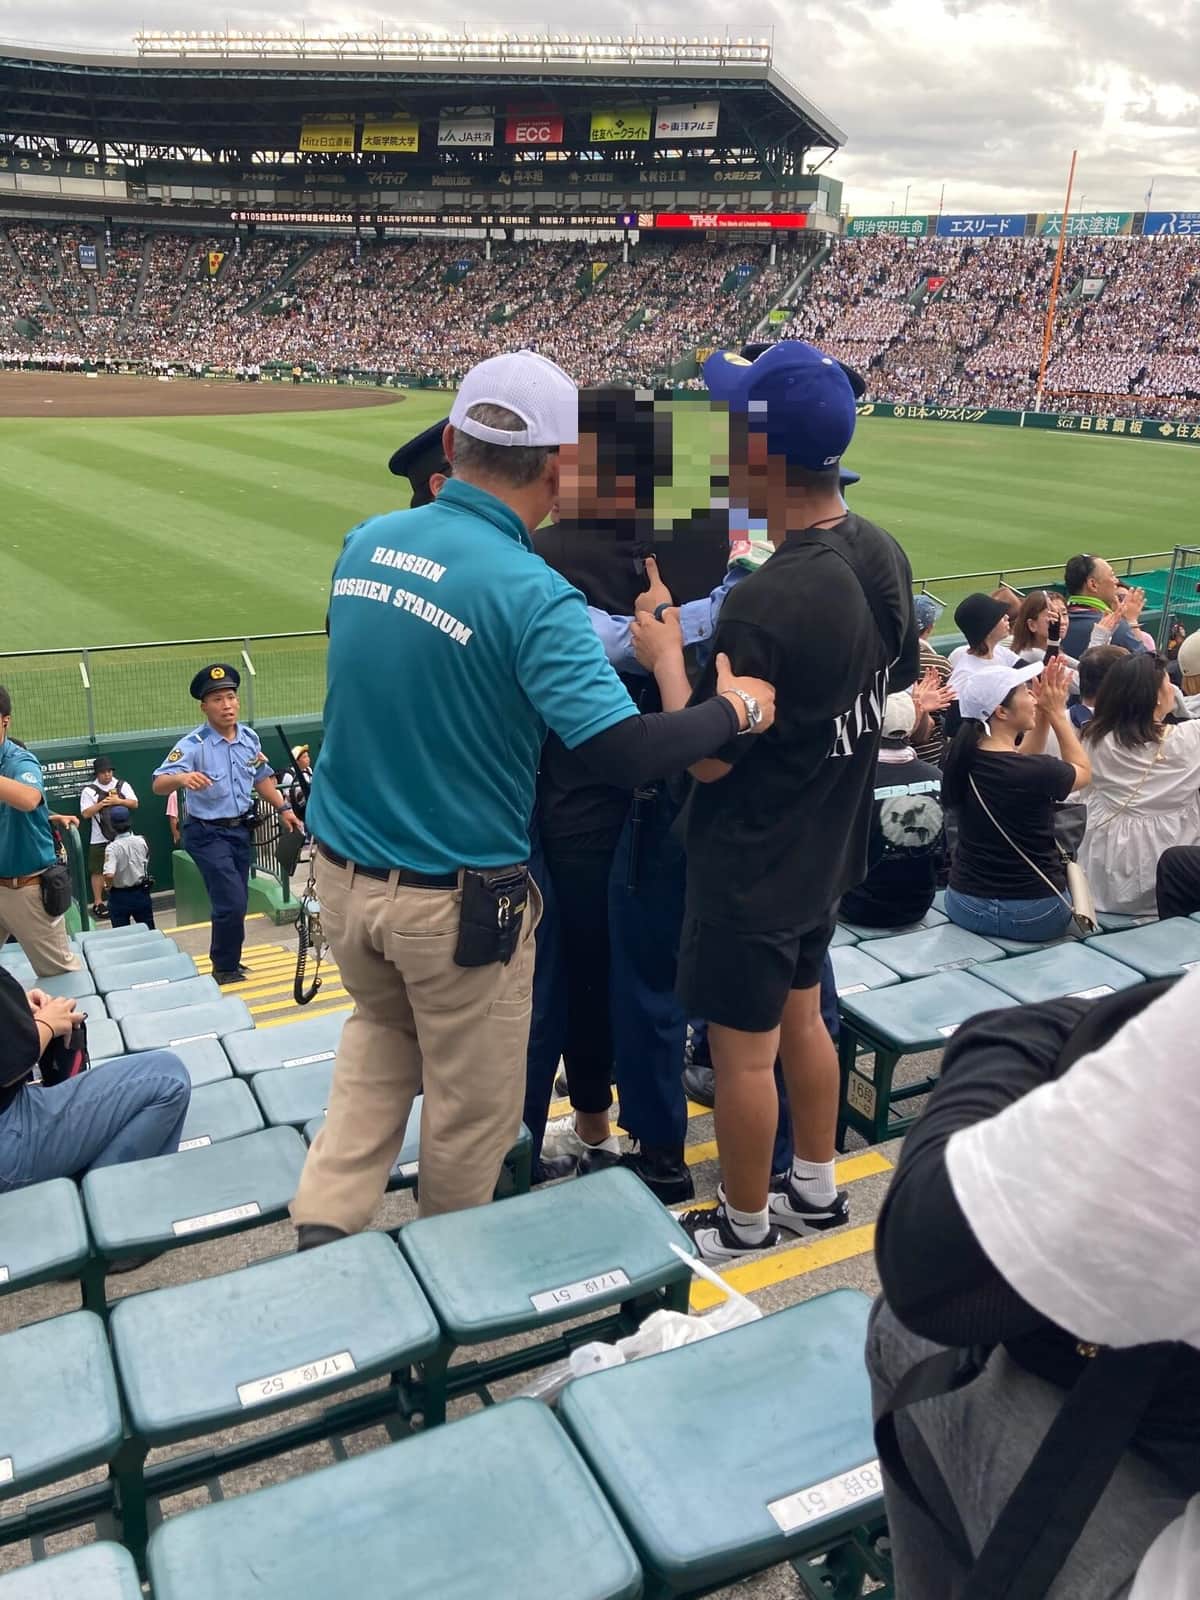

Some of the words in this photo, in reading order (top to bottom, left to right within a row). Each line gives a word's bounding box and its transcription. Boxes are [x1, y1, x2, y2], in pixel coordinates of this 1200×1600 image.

[592, 127, 648, 140] 住友ベークライト
[670, 121, 716, 132] 東洋アルミ
[458, 131, 492, 143] JA共済
[516, 127, 551, 143] ECC
[688, 214, 718, 227] THK
[853, 219, 923, 234] 明治安田生命
[951, 219, 1012, 233] エスリード
[1046, 215, 1121, 234] 大日本塗料
[908, 405, 987, 421] 日本ハウズイング
[370, 546, 447, 583] HANSHIN
[333, 578, 393, 603] KOSHIEN
[392, 588, 473, 646] STADIUM
[584, 1275, 618, 1294] 17段
[551, 1289, 572, 1304] 51
[302, 1359, 342, 1382] 17段
[261, 1377, 285, 1395] 52
[798, 1492, 826, 1516] 51
